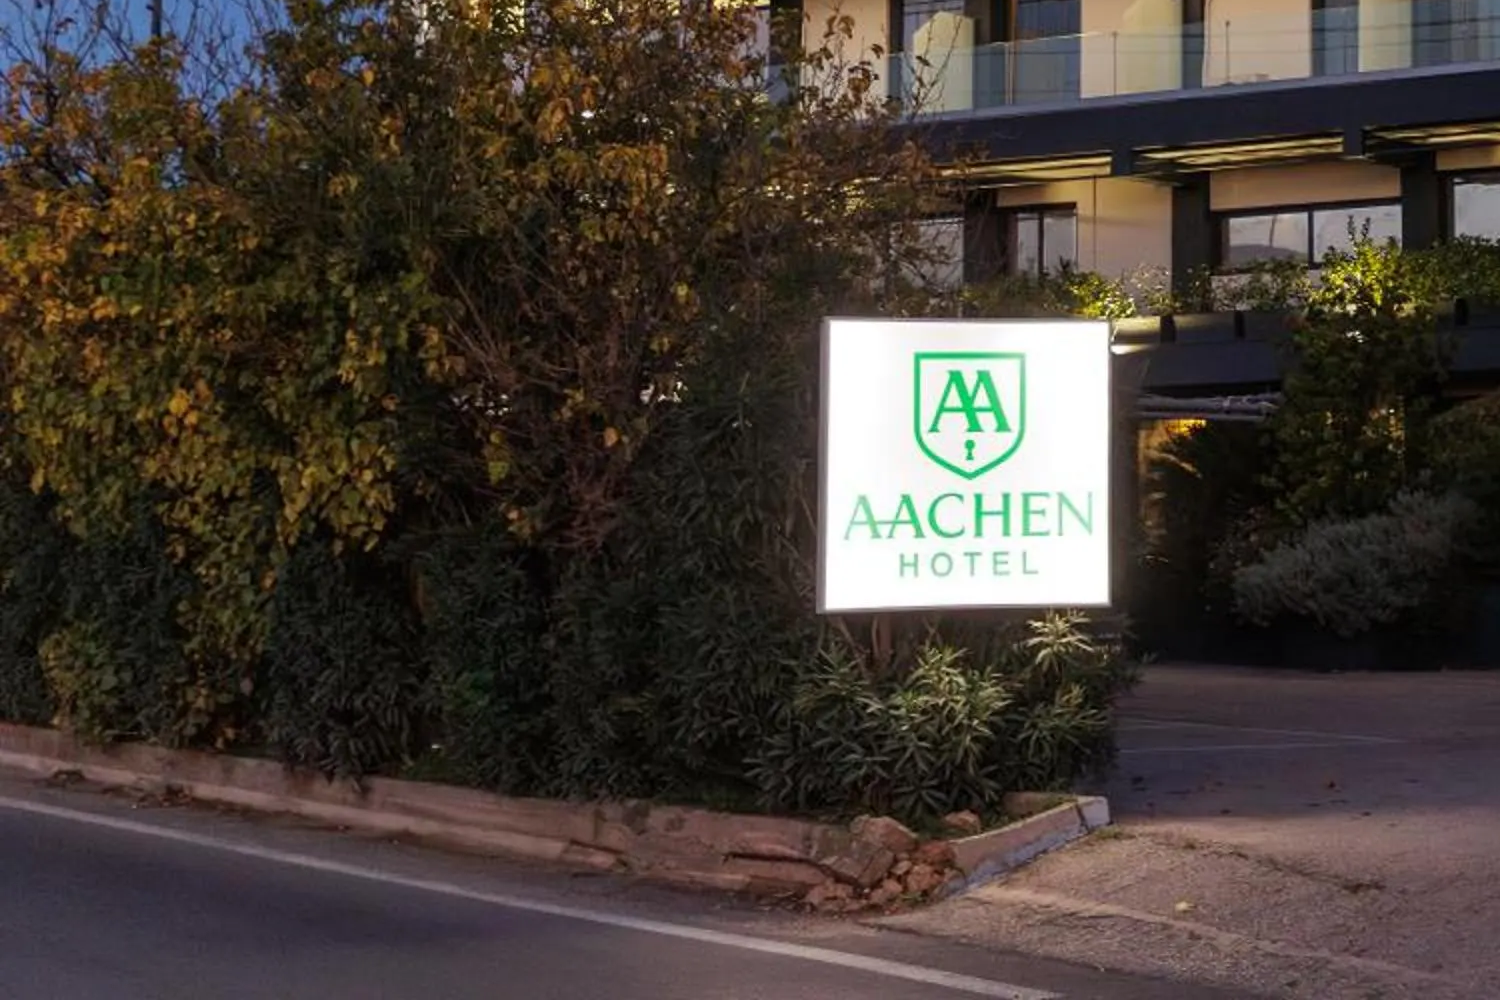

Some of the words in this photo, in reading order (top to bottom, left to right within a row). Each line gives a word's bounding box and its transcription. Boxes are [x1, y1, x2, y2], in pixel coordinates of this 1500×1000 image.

[928, 370, 1011, 433] AA
[843, 491, 1093, 540] AACHEN
[899, 551, 1039, 577] HOTEL
